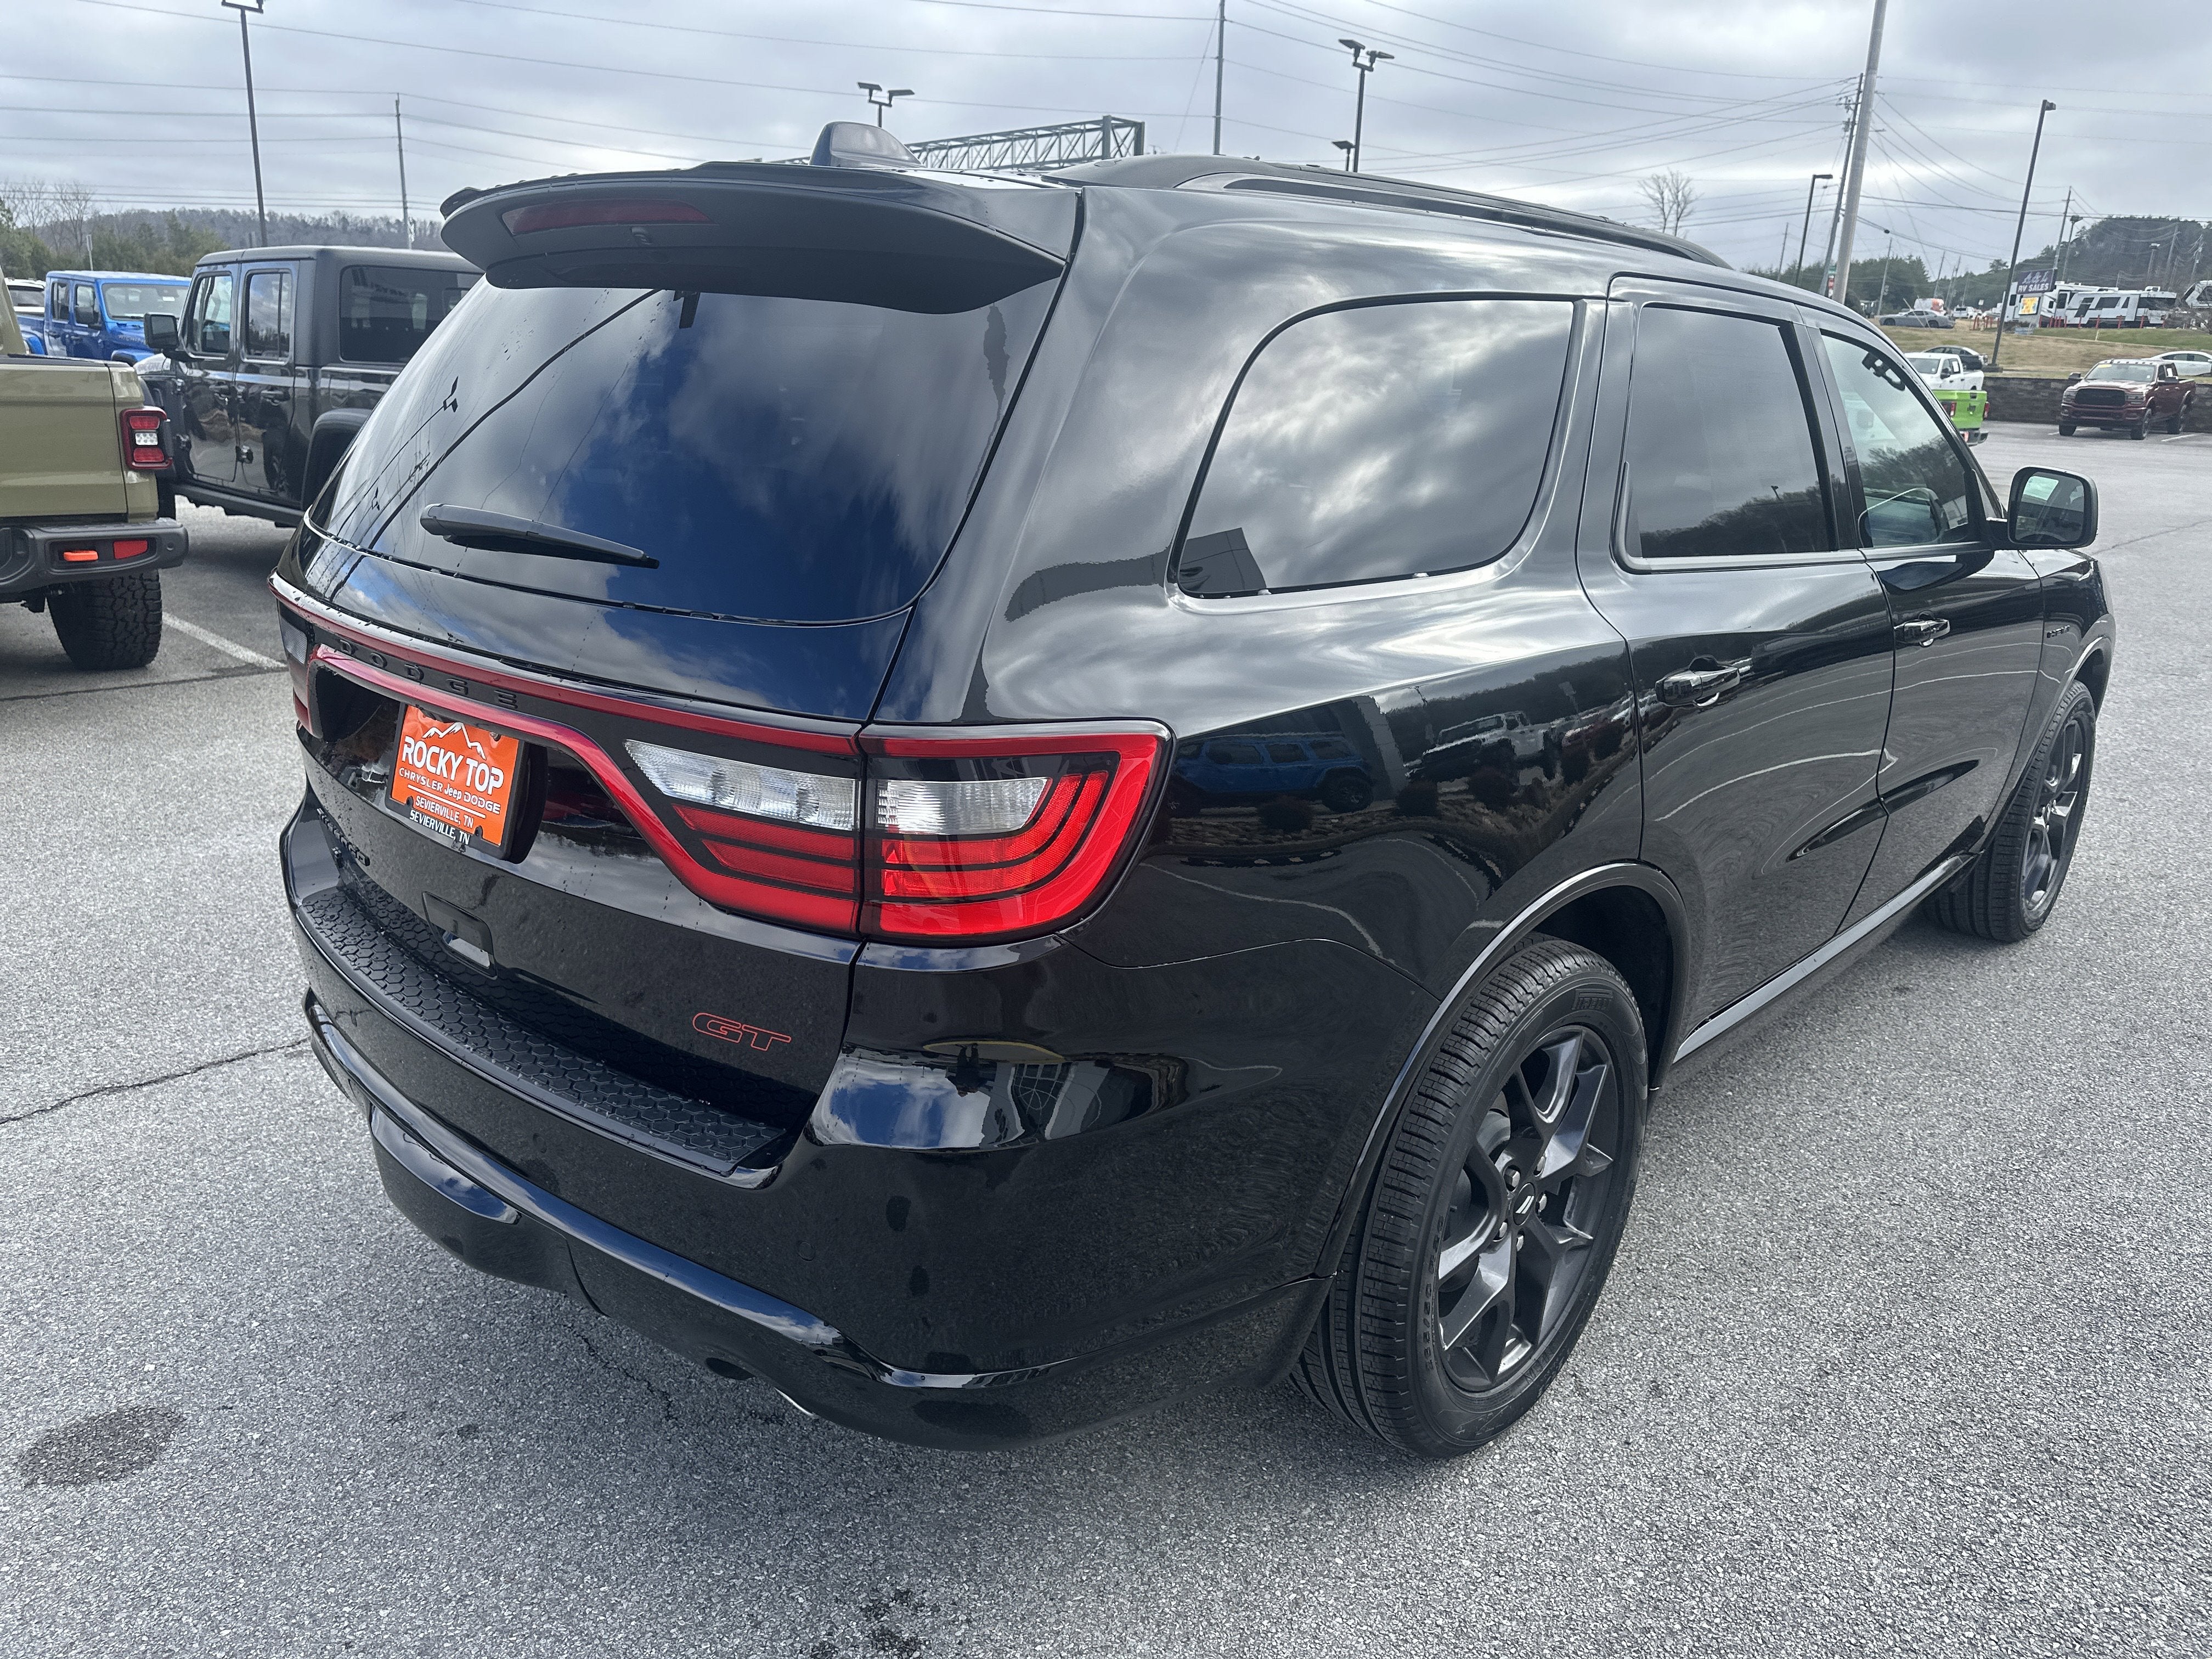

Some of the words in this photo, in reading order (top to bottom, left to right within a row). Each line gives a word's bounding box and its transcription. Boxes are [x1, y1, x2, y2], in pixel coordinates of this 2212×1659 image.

[2028, 283, 2049, 291] SALES
[340, 639, 517, 709] DODGE
[402, 735, 464, 781] ROCKY
[466, 757, 504, 795] TOP
[399, 767, 443, 793] CHRYSLER
[444, 783, 461, 801] Jeep
[464, 792, 501, 814] DODGE
[410, 809, 456, 840] SEVIERVILLE,
[459, 831, 470, 845] TN
[415, 795, 461, 825] SEVIERVILLE,
[464, 815, 474, 828] TN
[692, 1013, 792, 1051] GT
